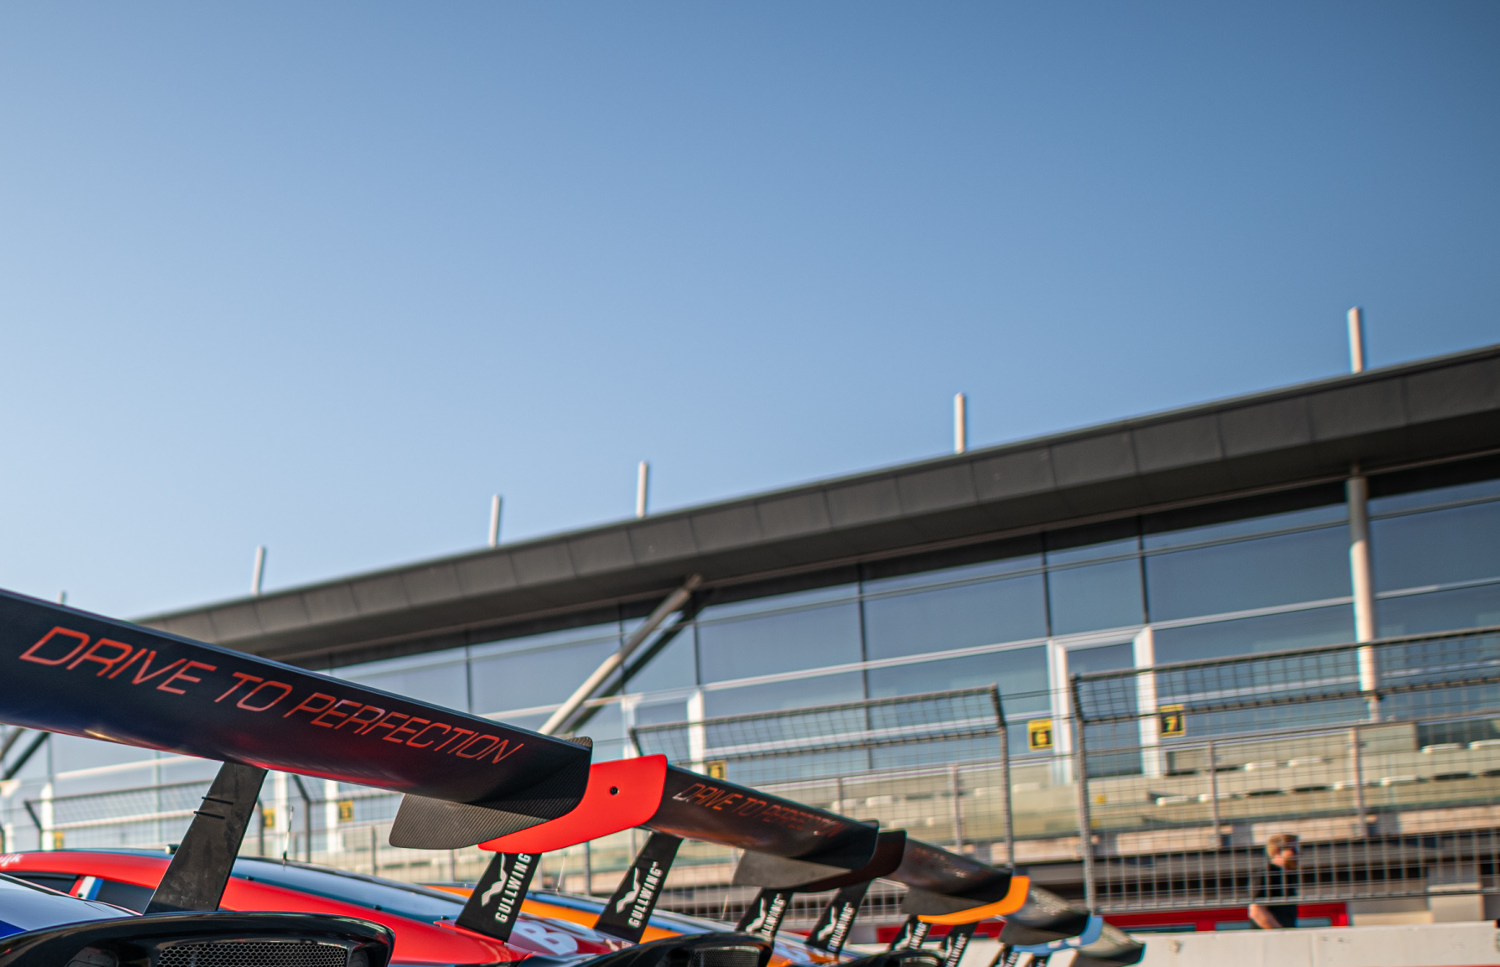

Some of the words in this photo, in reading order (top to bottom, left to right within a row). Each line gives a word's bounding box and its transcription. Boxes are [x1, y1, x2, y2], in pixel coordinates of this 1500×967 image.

[20, 626, 216, 695] DRIVE
[215, 671, 292, 712] TO
[283, 692, 524, 765] PERFECTION
[495, 853, 532, 924] GULLWING
